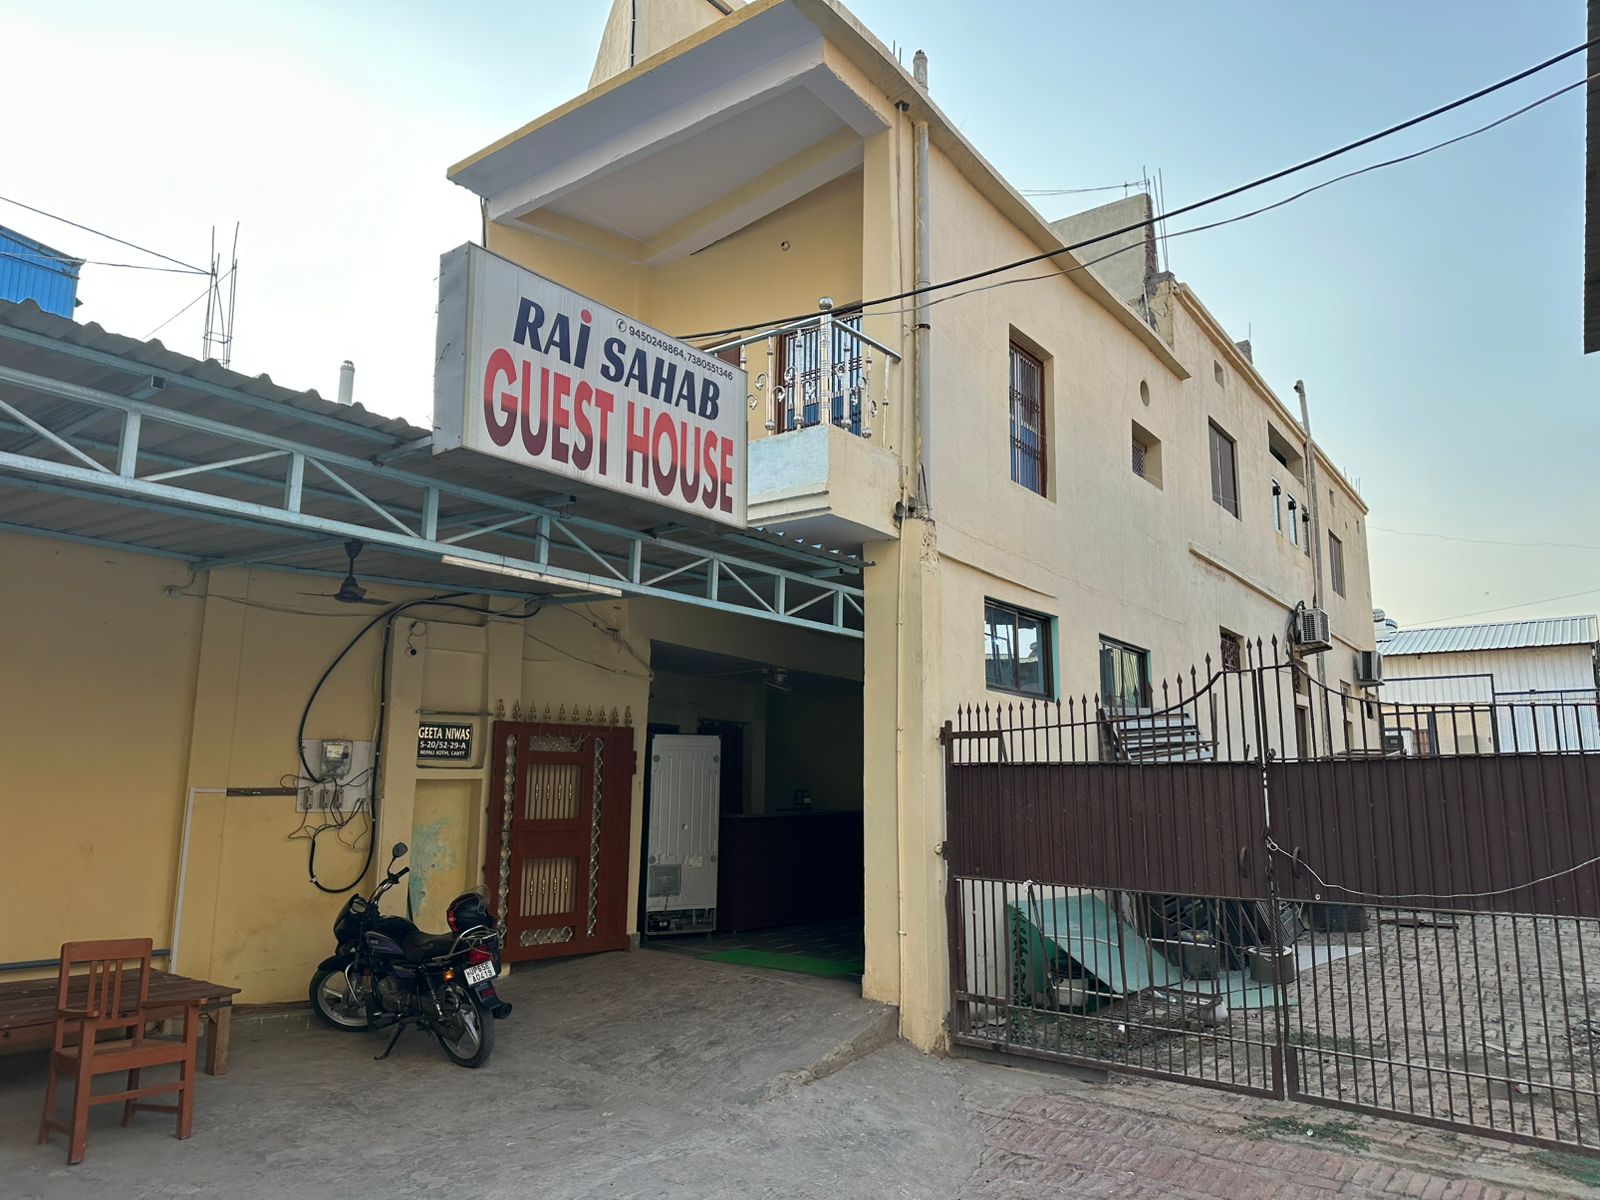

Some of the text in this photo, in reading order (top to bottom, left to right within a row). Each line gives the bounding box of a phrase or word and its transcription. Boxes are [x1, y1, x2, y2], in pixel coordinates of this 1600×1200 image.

[600, 337, 720, 421] SAHAB
[483, 348, 733, 514] GUEST HOUSE
[418, 726, 470, 740] GEETA NIWAS
